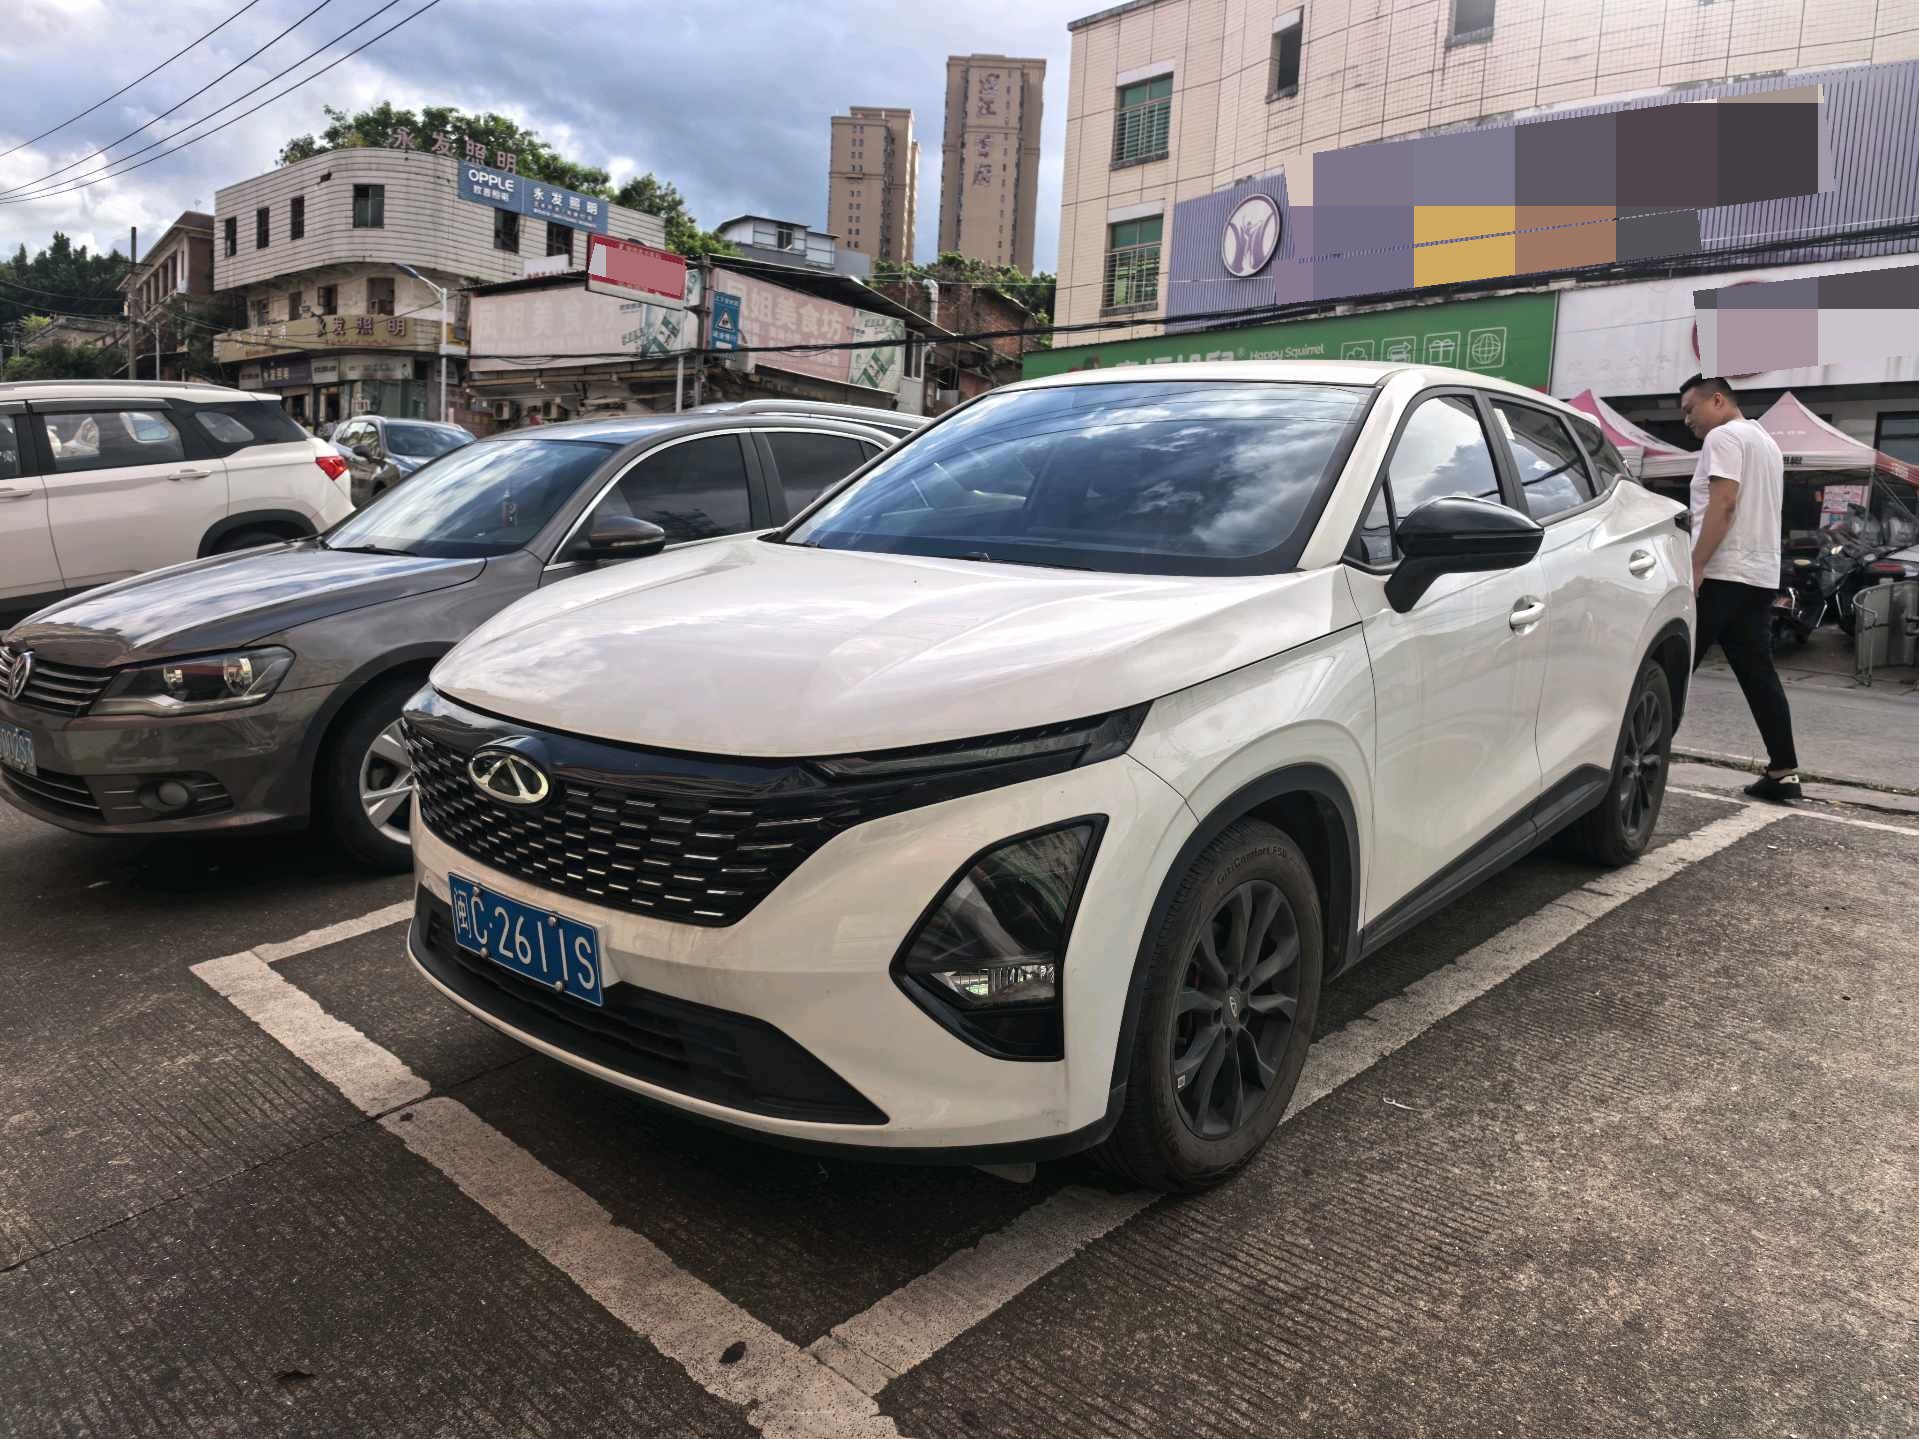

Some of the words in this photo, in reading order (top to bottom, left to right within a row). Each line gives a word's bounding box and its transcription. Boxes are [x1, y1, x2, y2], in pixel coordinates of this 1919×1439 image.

[394, 127, 517, 175] 永发照明
[468, 169, 515, 193] OPPLE
[1250, 350, 1283, 360] Happy
[1285, 343, 1325, 360] Squirrel
